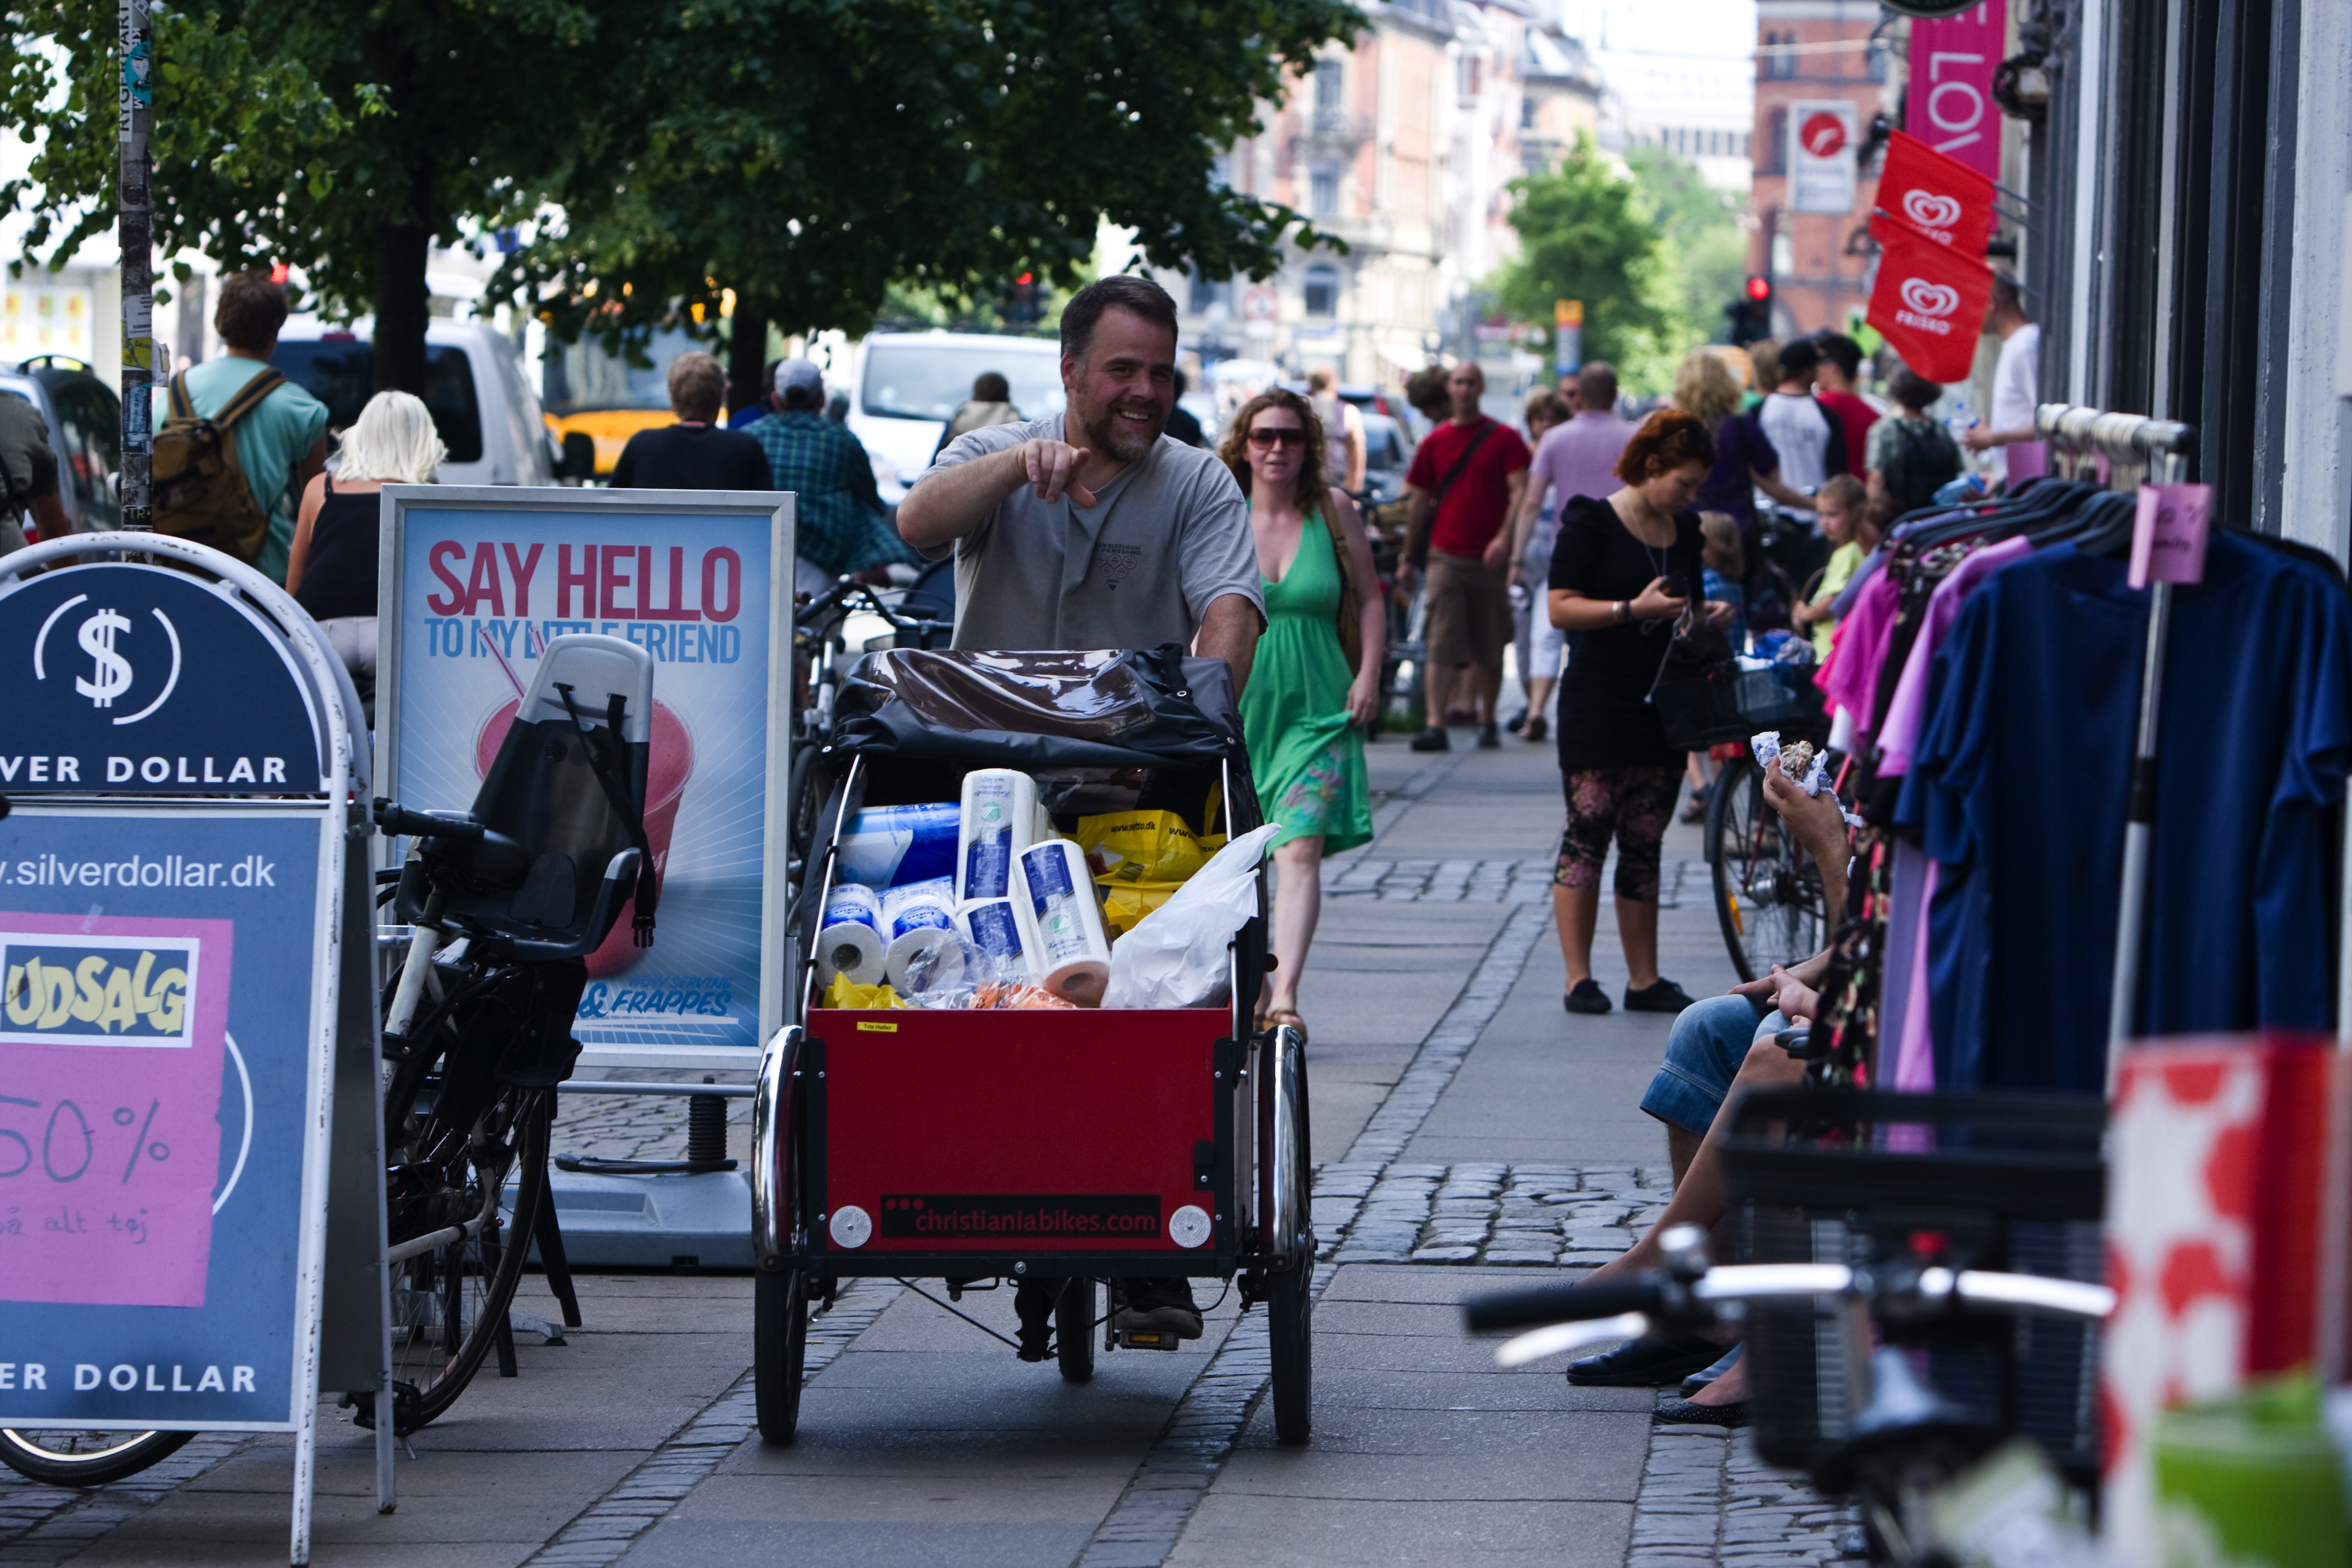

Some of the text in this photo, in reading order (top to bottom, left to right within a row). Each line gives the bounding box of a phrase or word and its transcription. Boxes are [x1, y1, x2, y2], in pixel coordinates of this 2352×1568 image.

[427, 540, 741, 622] SAY HELLO
[424, 618, 463, 657] TO
[107, 756, 287, 783] DOLLAR
[1111, 821, 1156, 832] www.netto.dk
[6, 951, 187, 1034] UDSALG
[629, 974, 734, 989] NOW SERVING
[577, 982, 732, 1018] & FRAPPES
[44, 1206, 87, 1234] alt
[916, 1208, 1156, 1231] christianiabikes.com
[74, 1364, 257, 1393] DOLLAR
